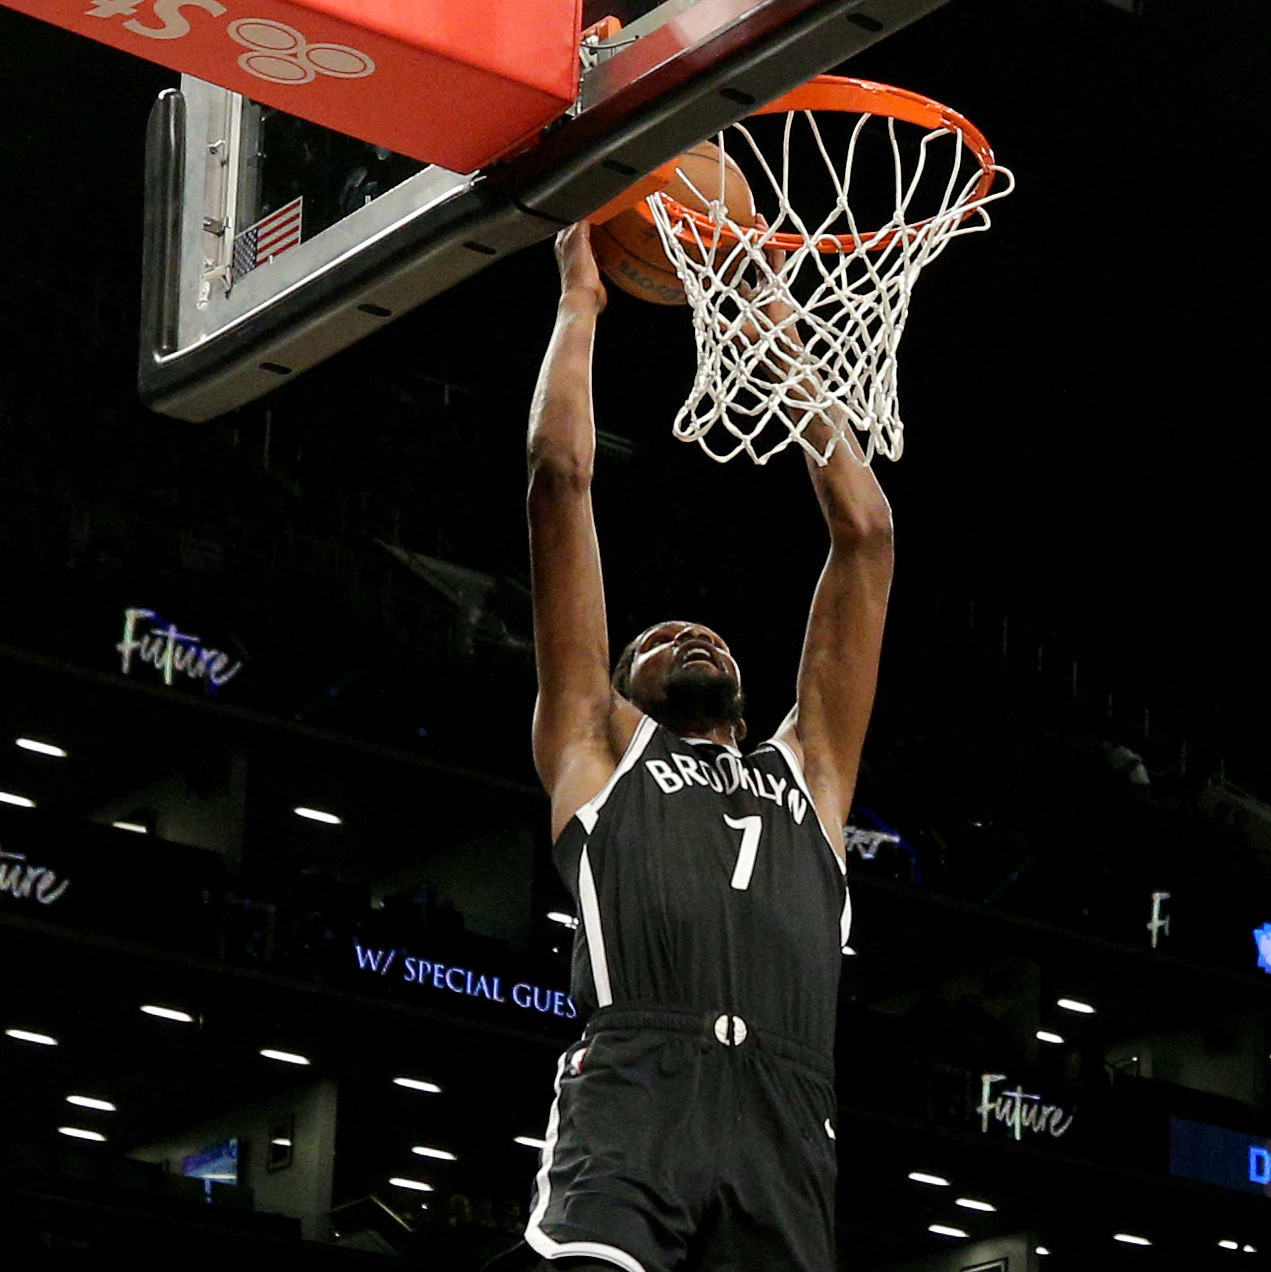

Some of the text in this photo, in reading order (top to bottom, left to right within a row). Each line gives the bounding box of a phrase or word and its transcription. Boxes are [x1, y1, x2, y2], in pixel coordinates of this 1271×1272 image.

[116, 607, 242, 686] Future
[645, 752, 808, 825] BROOKLYN
[723, 813, 763, 890] 7
[354, 944, 578, 1020] W/ SPECIAL GUES
[976, 1073, 1074, 1141] Future
